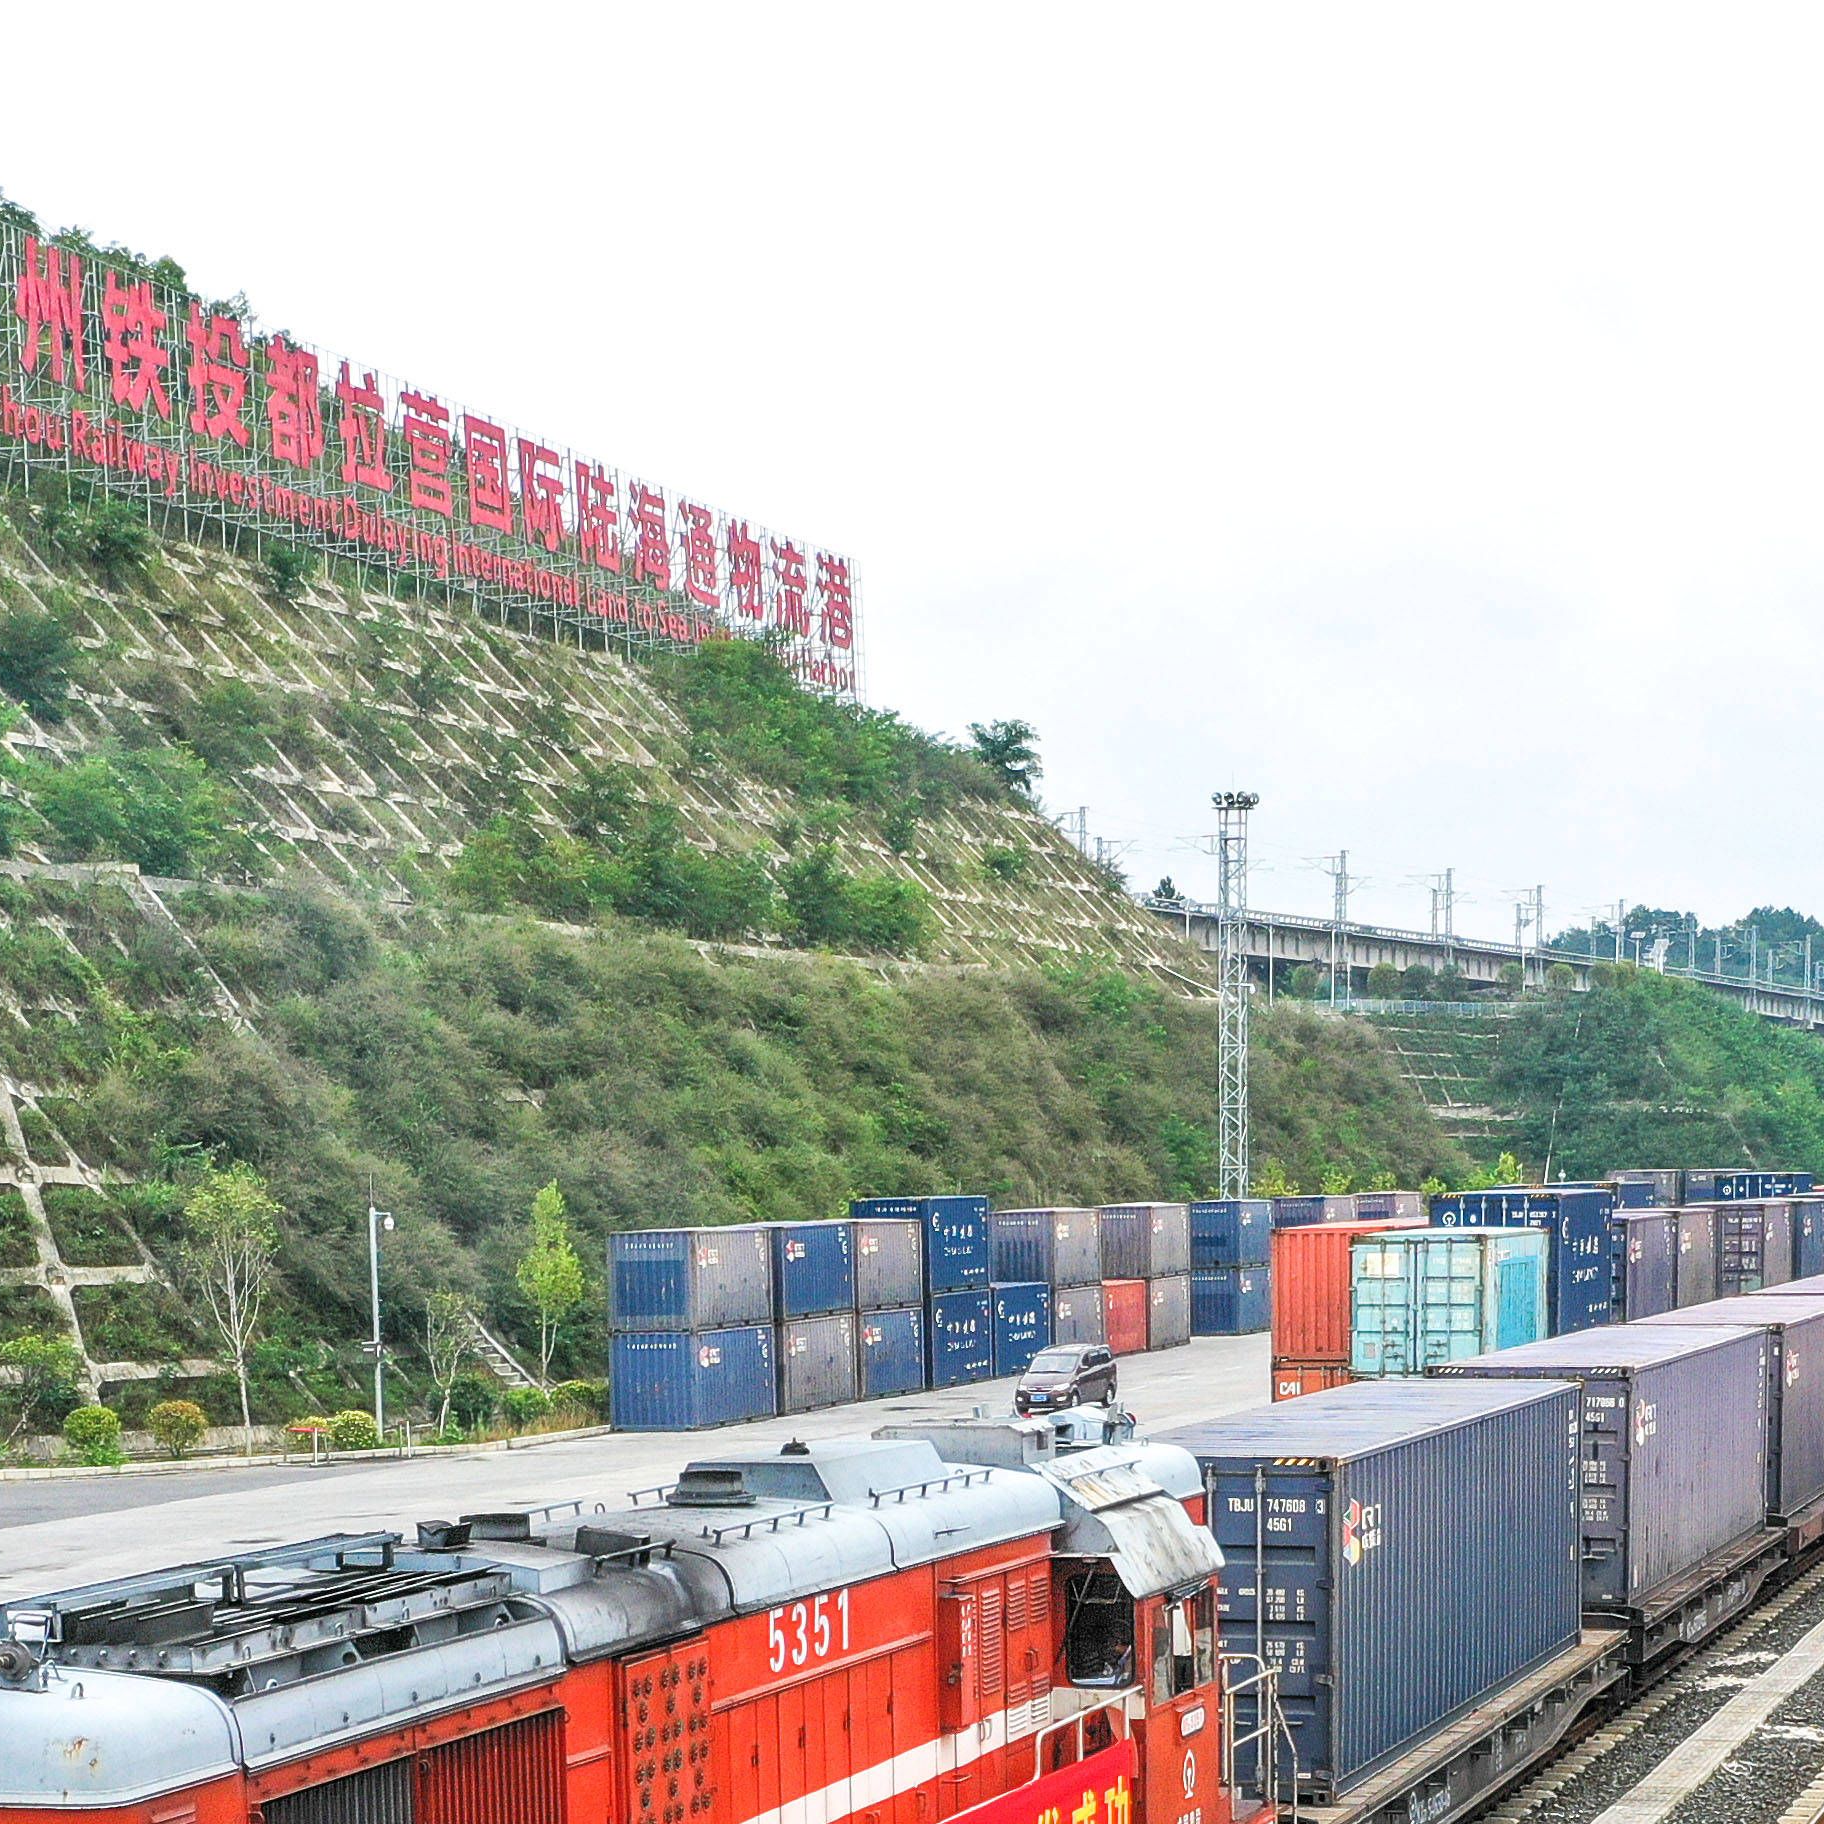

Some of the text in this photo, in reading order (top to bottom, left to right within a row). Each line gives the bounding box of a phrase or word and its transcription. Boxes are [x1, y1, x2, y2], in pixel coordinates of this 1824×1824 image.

[72, 408, 179, 497] Railway
[188, 447, 342, 535] Investment
[452, 522, 579, 608] International
[586, 577, 626, 622] Land
[635, 596, 653, 630] to
[657, 600, 690, 642] Sea
[1279, 1382, 1301, 1395] CAI
[1228, 1497, 1325, 1514] TBJU 747608 3
[1266, 1517, 1292, 1532] 45G1
[767, 1587, 852, 1675] 5351
